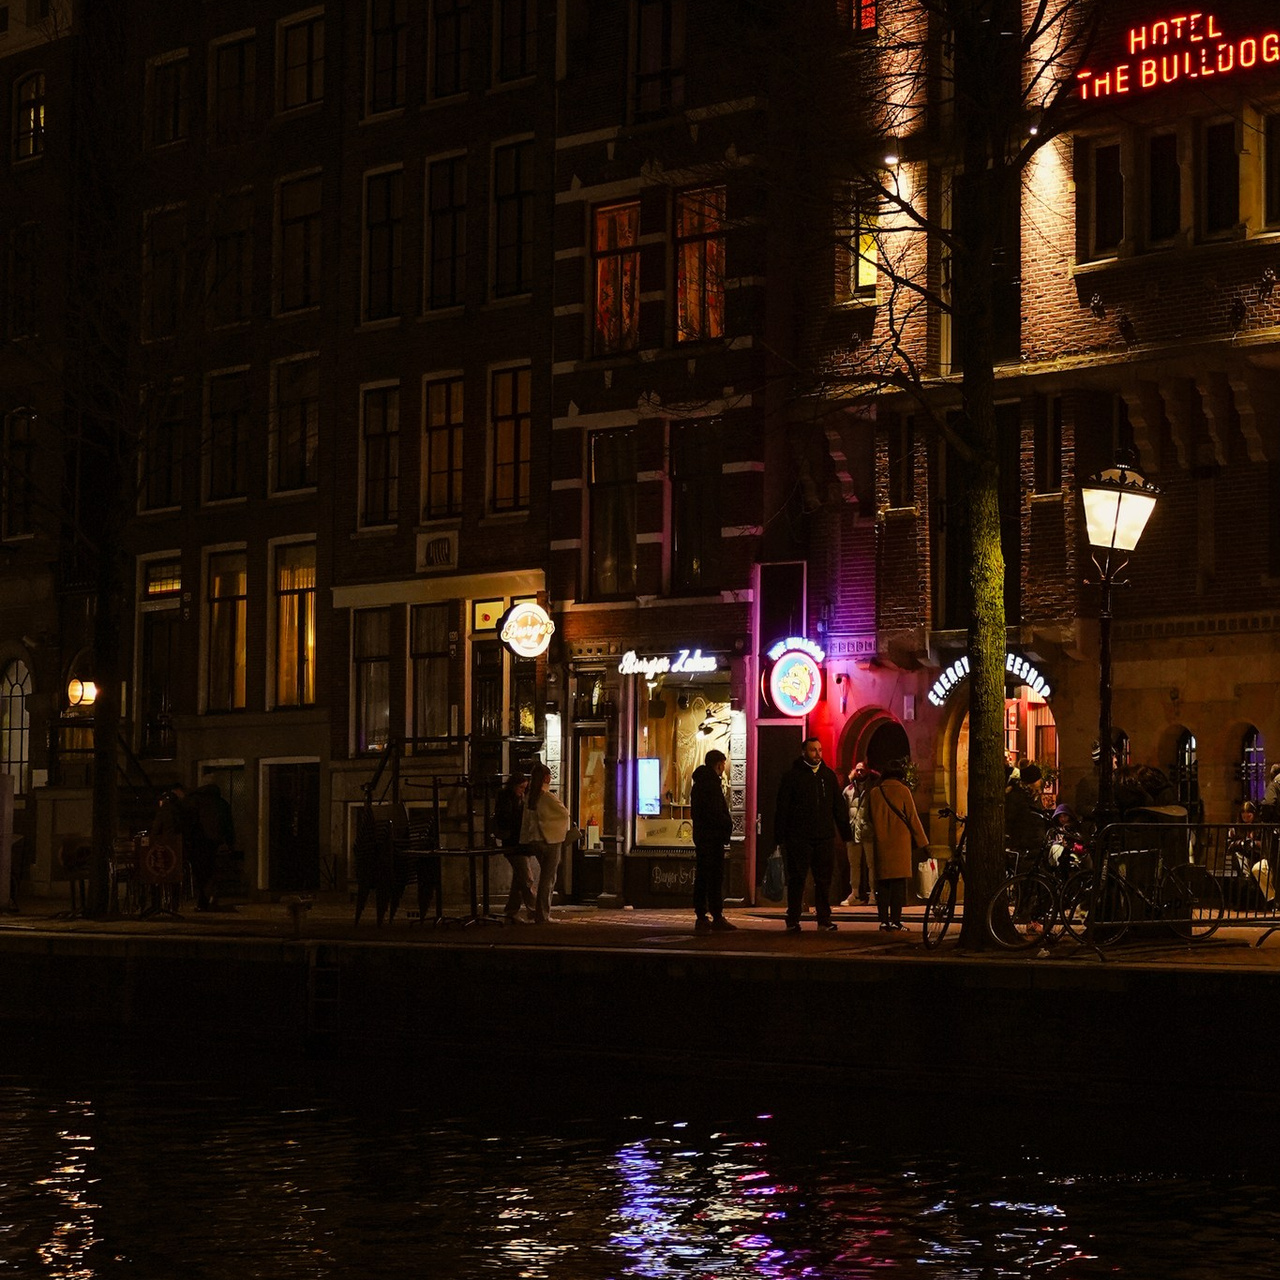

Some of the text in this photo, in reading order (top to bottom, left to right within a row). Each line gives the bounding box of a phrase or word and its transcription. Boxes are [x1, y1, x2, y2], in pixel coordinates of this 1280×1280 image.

[1130, 13, 1222, 55] HOTEL
[1077, 33, 1280, 99] THE BULLDOG
[928, 653, 1051, 706] ENERGY EESHOP
